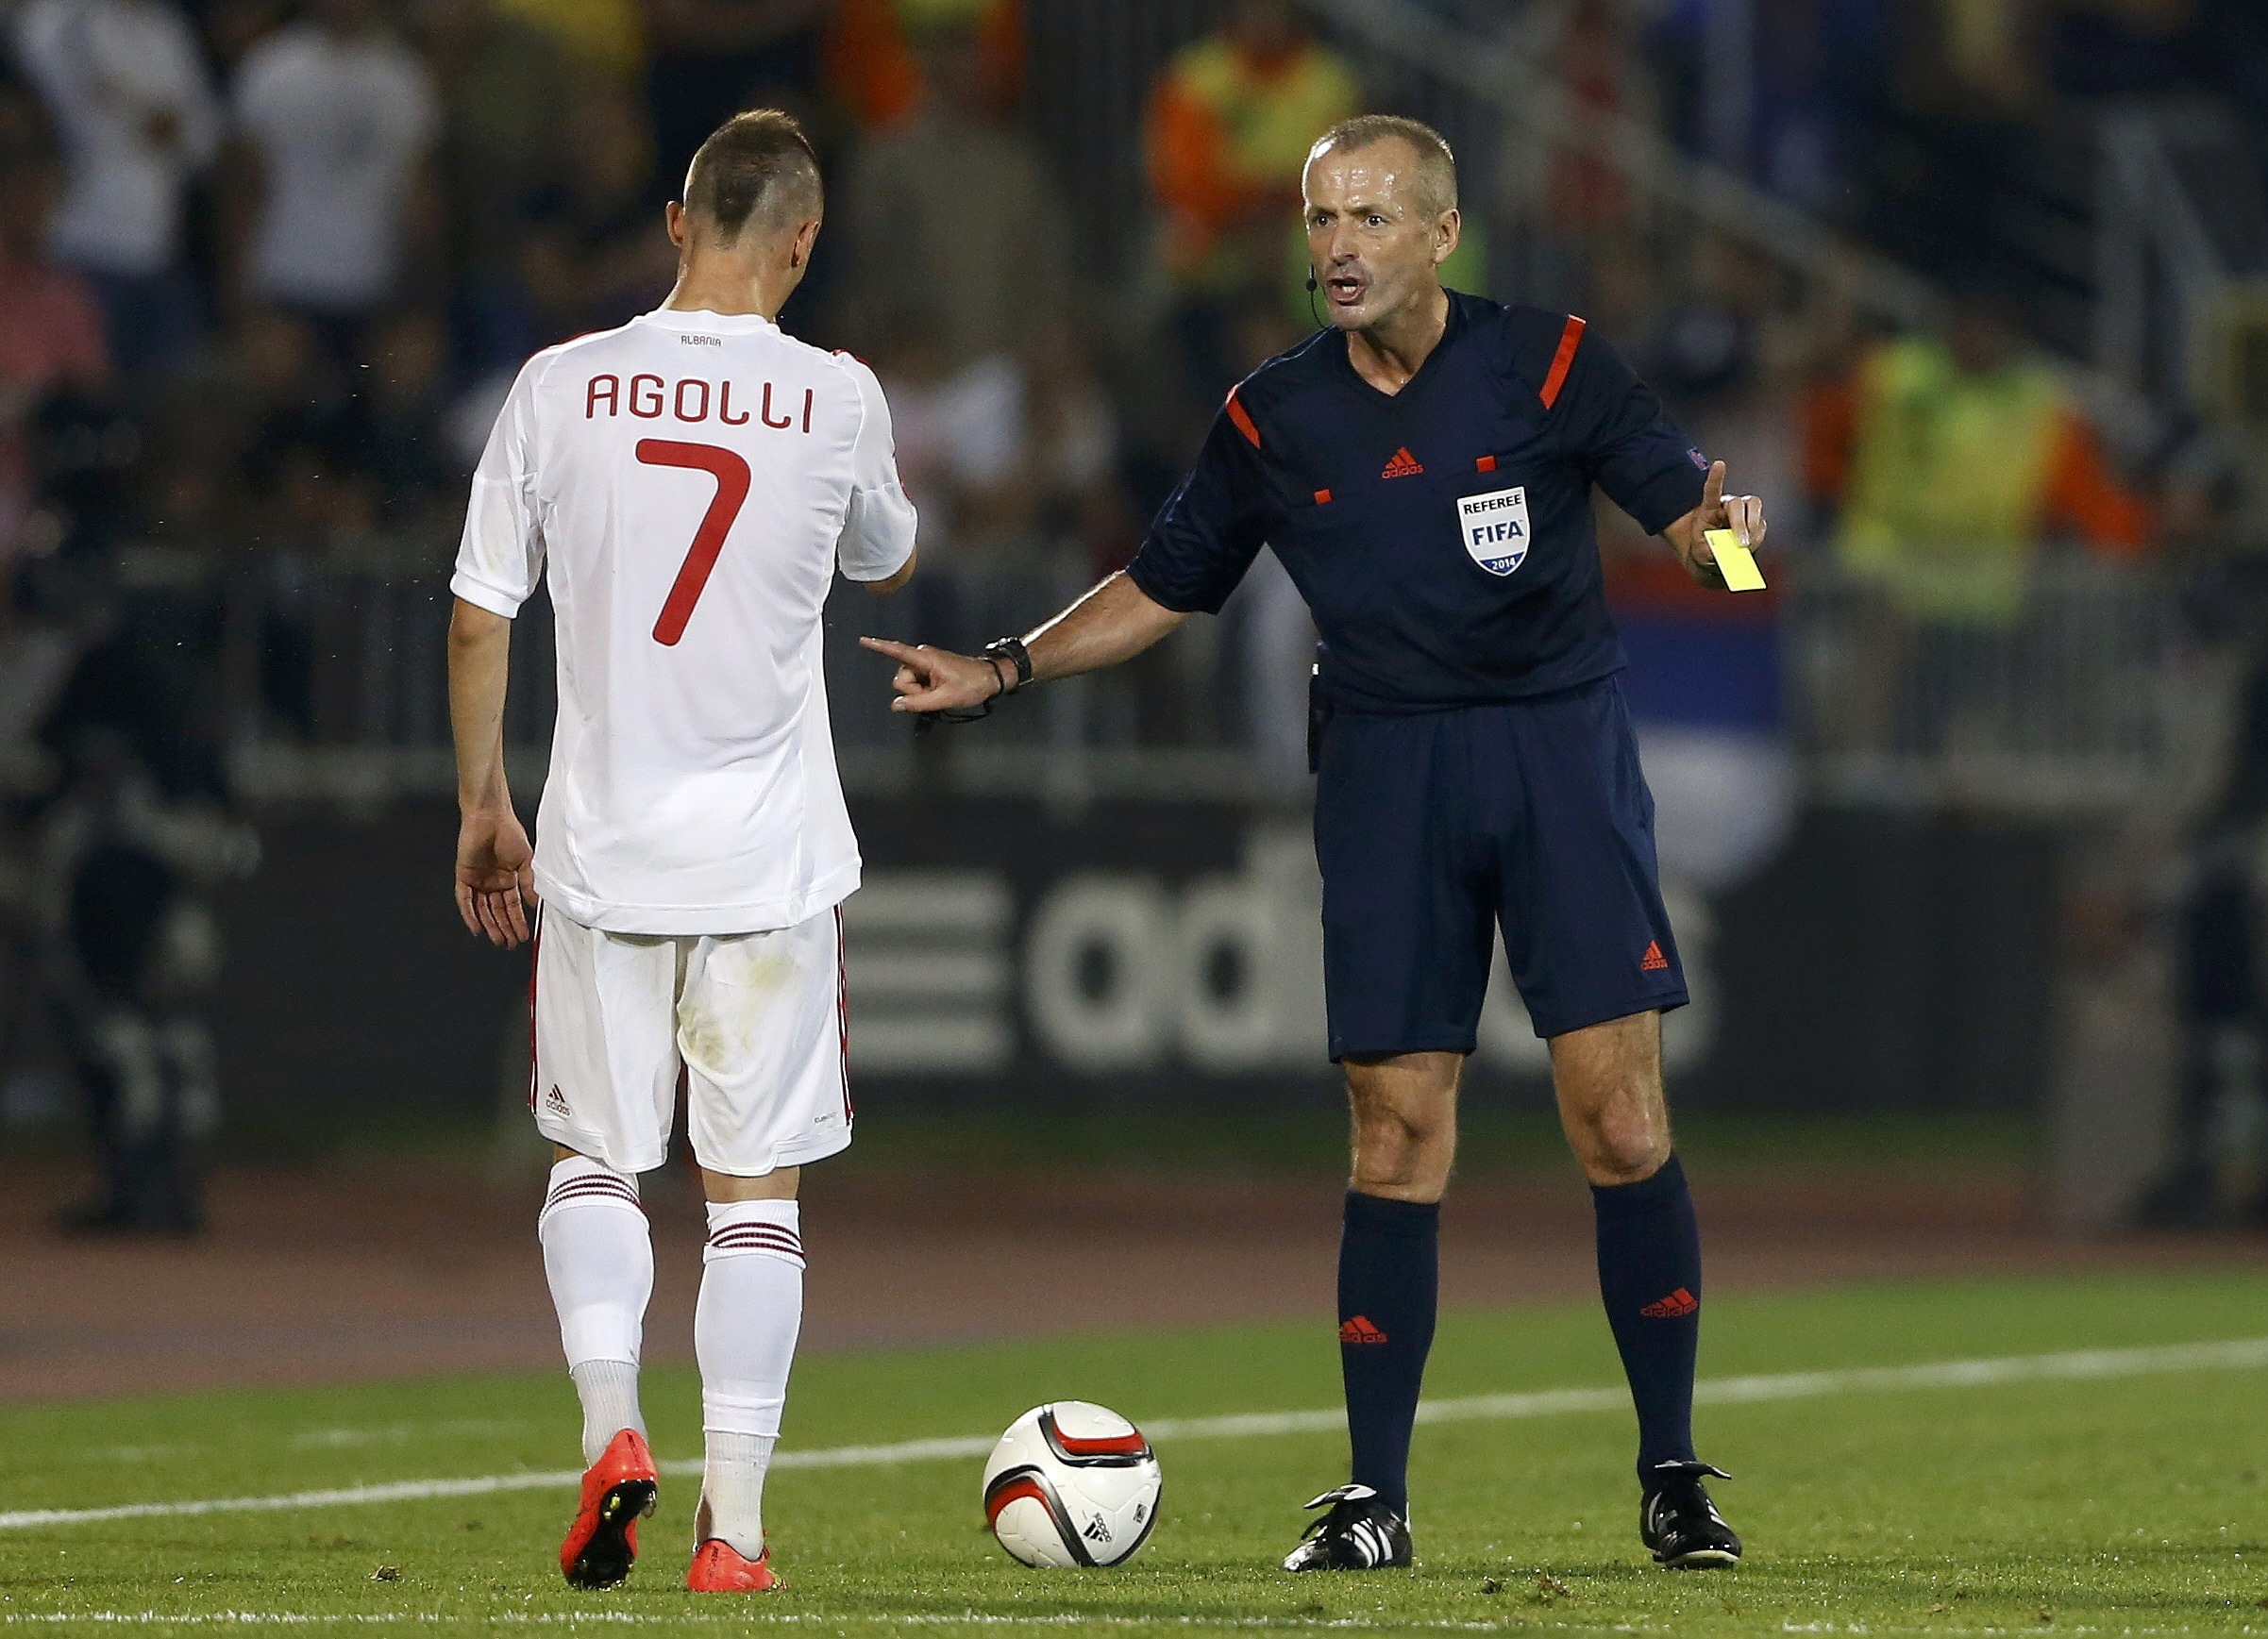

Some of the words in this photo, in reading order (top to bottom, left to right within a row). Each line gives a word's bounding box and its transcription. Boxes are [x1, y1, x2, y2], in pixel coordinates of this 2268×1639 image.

[680, 334, 722, 347] ALBANIA
[584, 373, 814, 435] AGOLLI
[1381, 463, 1425, 479] adidas
[1463, 493, 1522, 515] REFEREE
[635, 438, 752, 647] 7
[1471, 520, 1525, 546] FIFA
[1490, 557, 1517, 571] 2014
